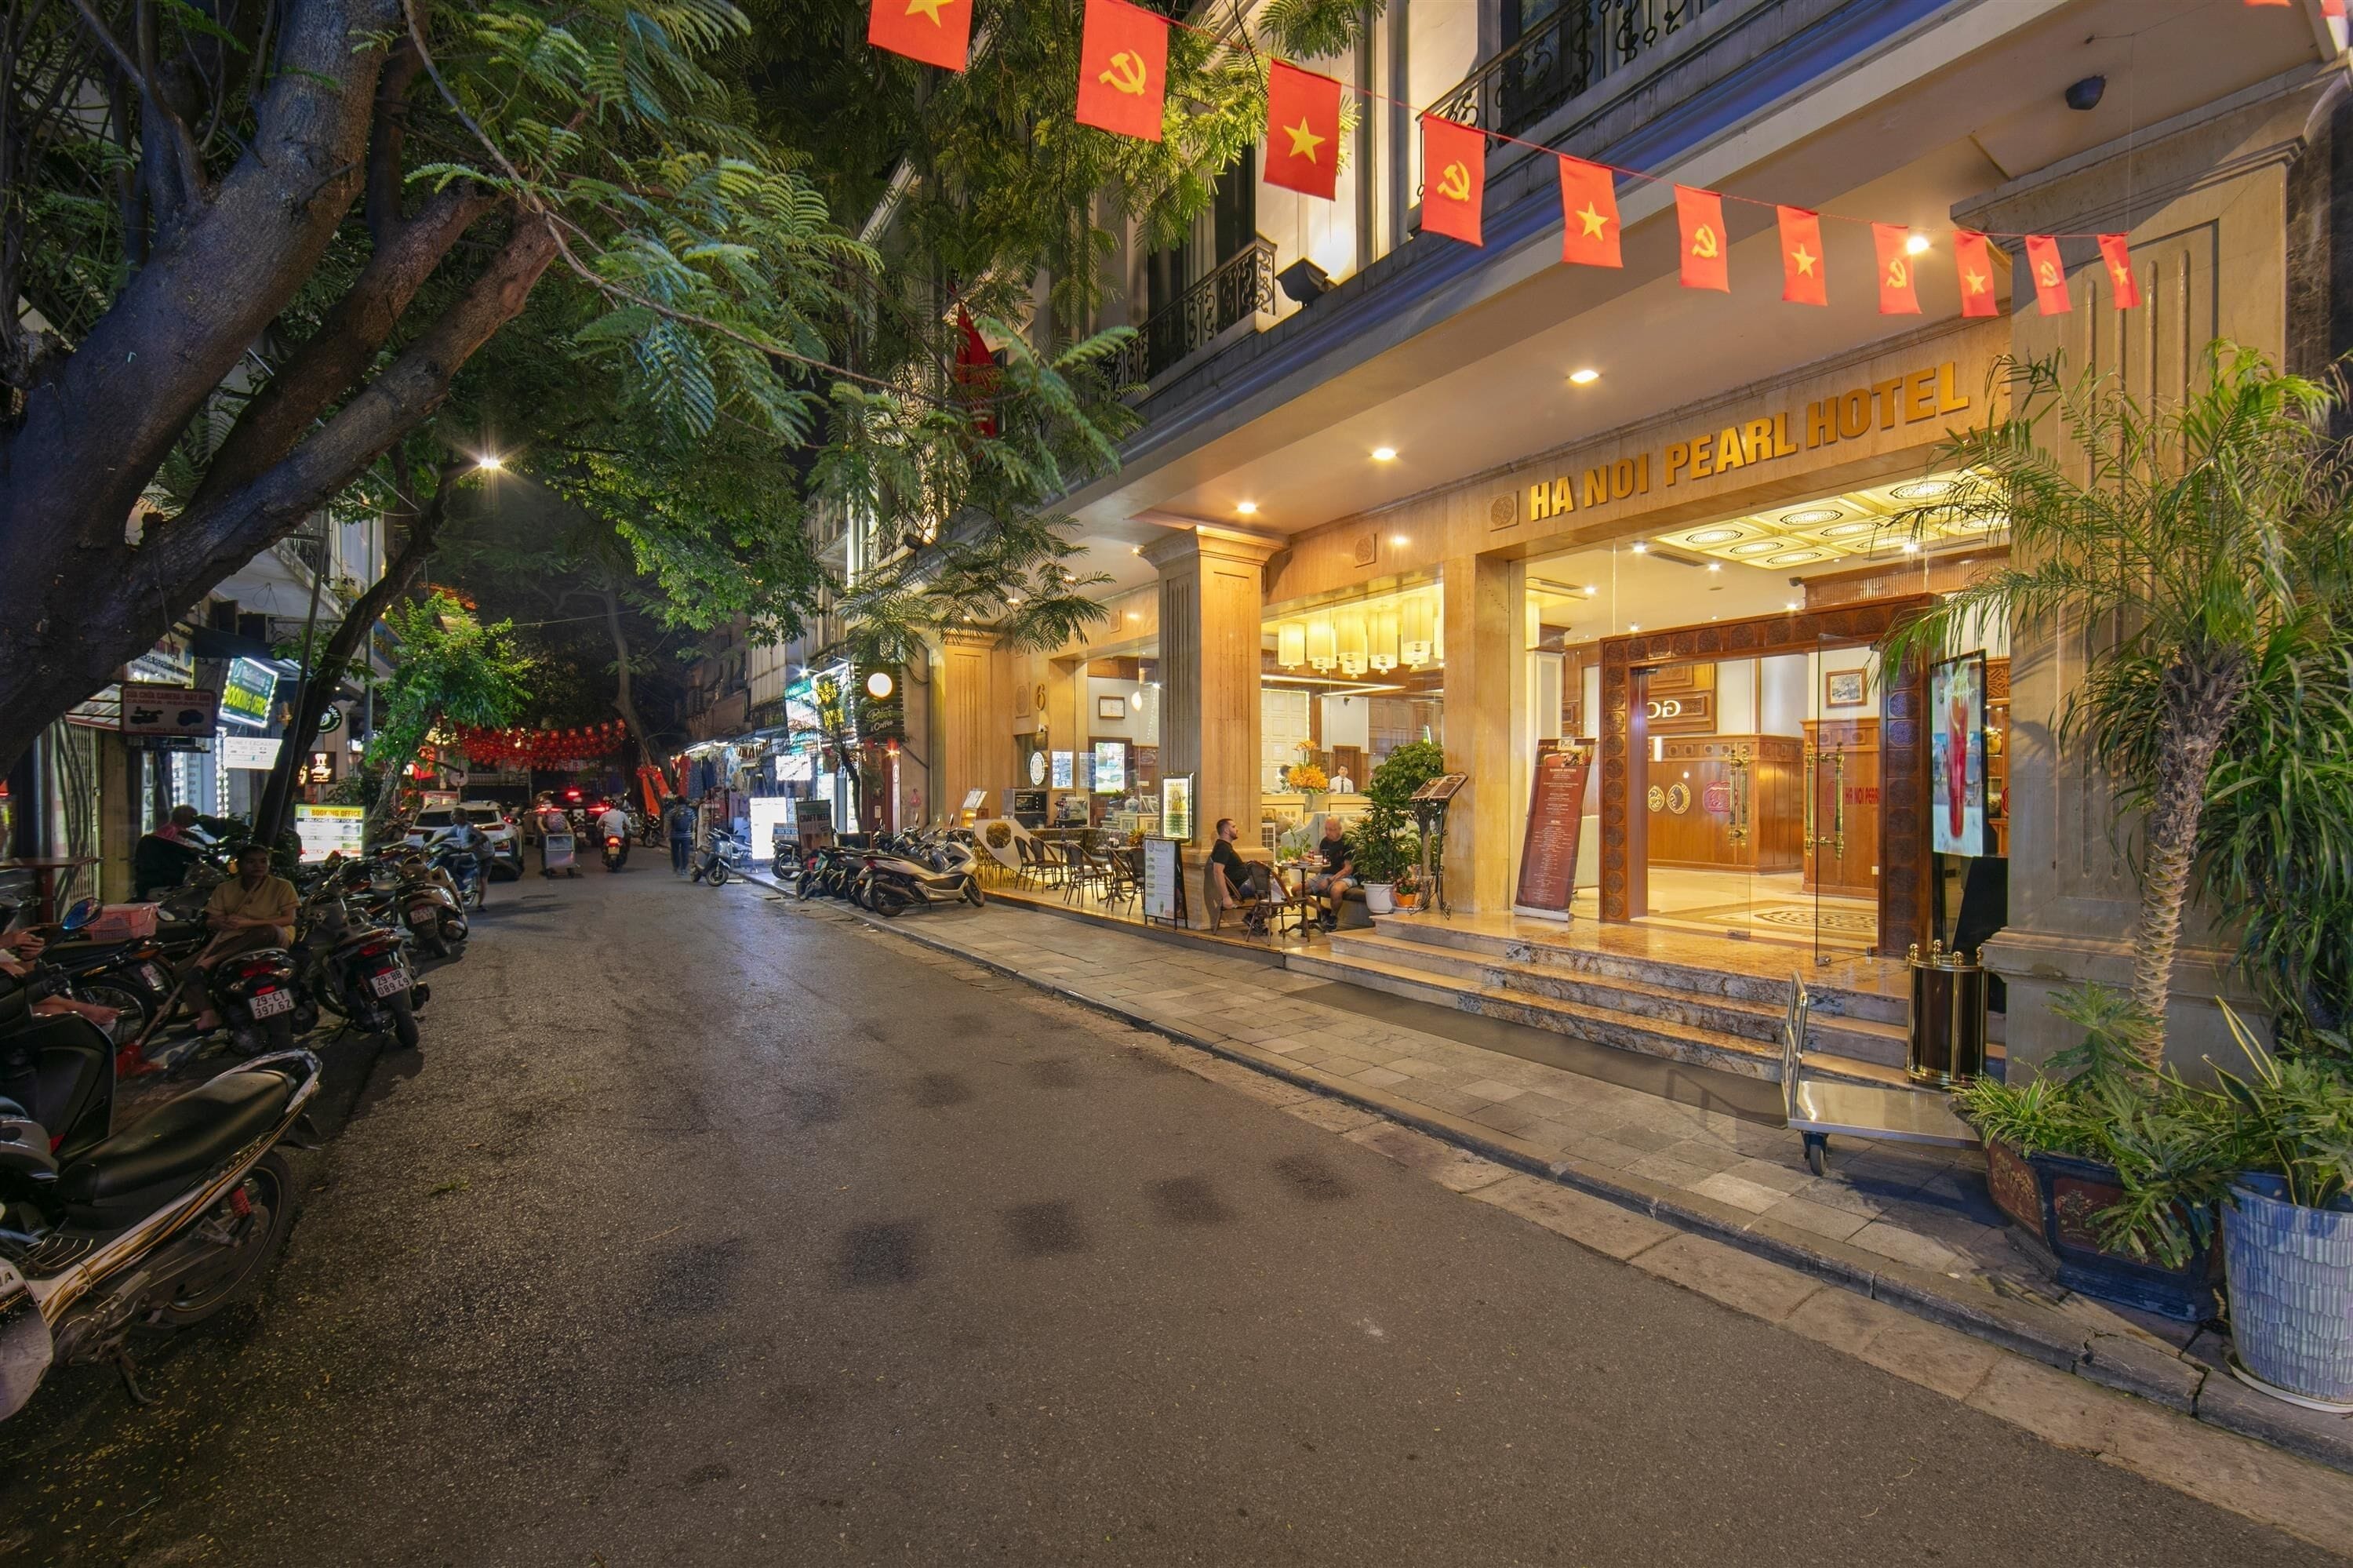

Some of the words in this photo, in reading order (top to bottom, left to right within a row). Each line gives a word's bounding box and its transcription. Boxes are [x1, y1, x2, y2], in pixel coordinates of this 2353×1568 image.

[1530, 476, 1573, 521] HA
[1584, 451, 1649, 507] NOI
[1664, 412, 1798, 486] PEARL
[1807, 362, 1969, 448] HOTEL
[1036, 684, 1046, 711] 6
[874, 720, 894, 730] Coffee
[1854, 787, 1864, 805] NOI
[799, 814, 816, 823] CRAFT
[255, 991, 285, 1007] 29-C1
[255, 999, 293, 1018] 397.62
